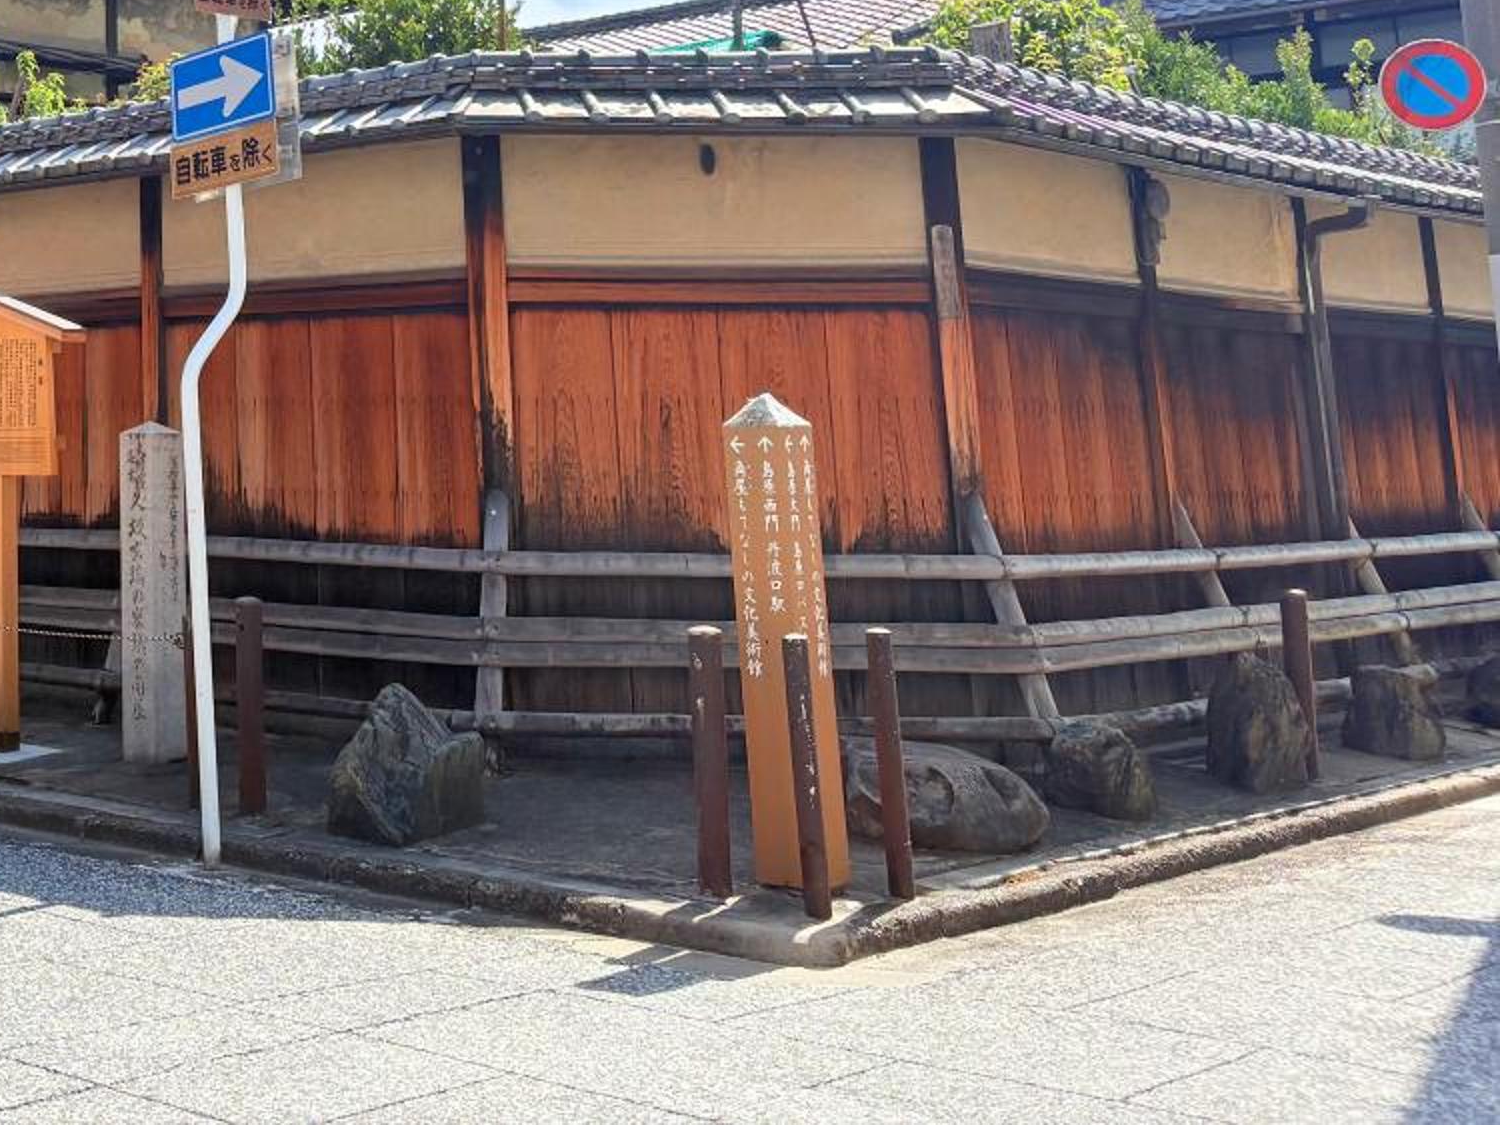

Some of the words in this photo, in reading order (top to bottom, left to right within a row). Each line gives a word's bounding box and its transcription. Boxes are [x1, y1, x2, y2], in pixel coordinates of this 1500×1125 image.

[175, 139, 273, 185] 自転車を除く
[763, 460, 779, 532] 島原西門
[767, 541, 787, 613] 丹波口駅
